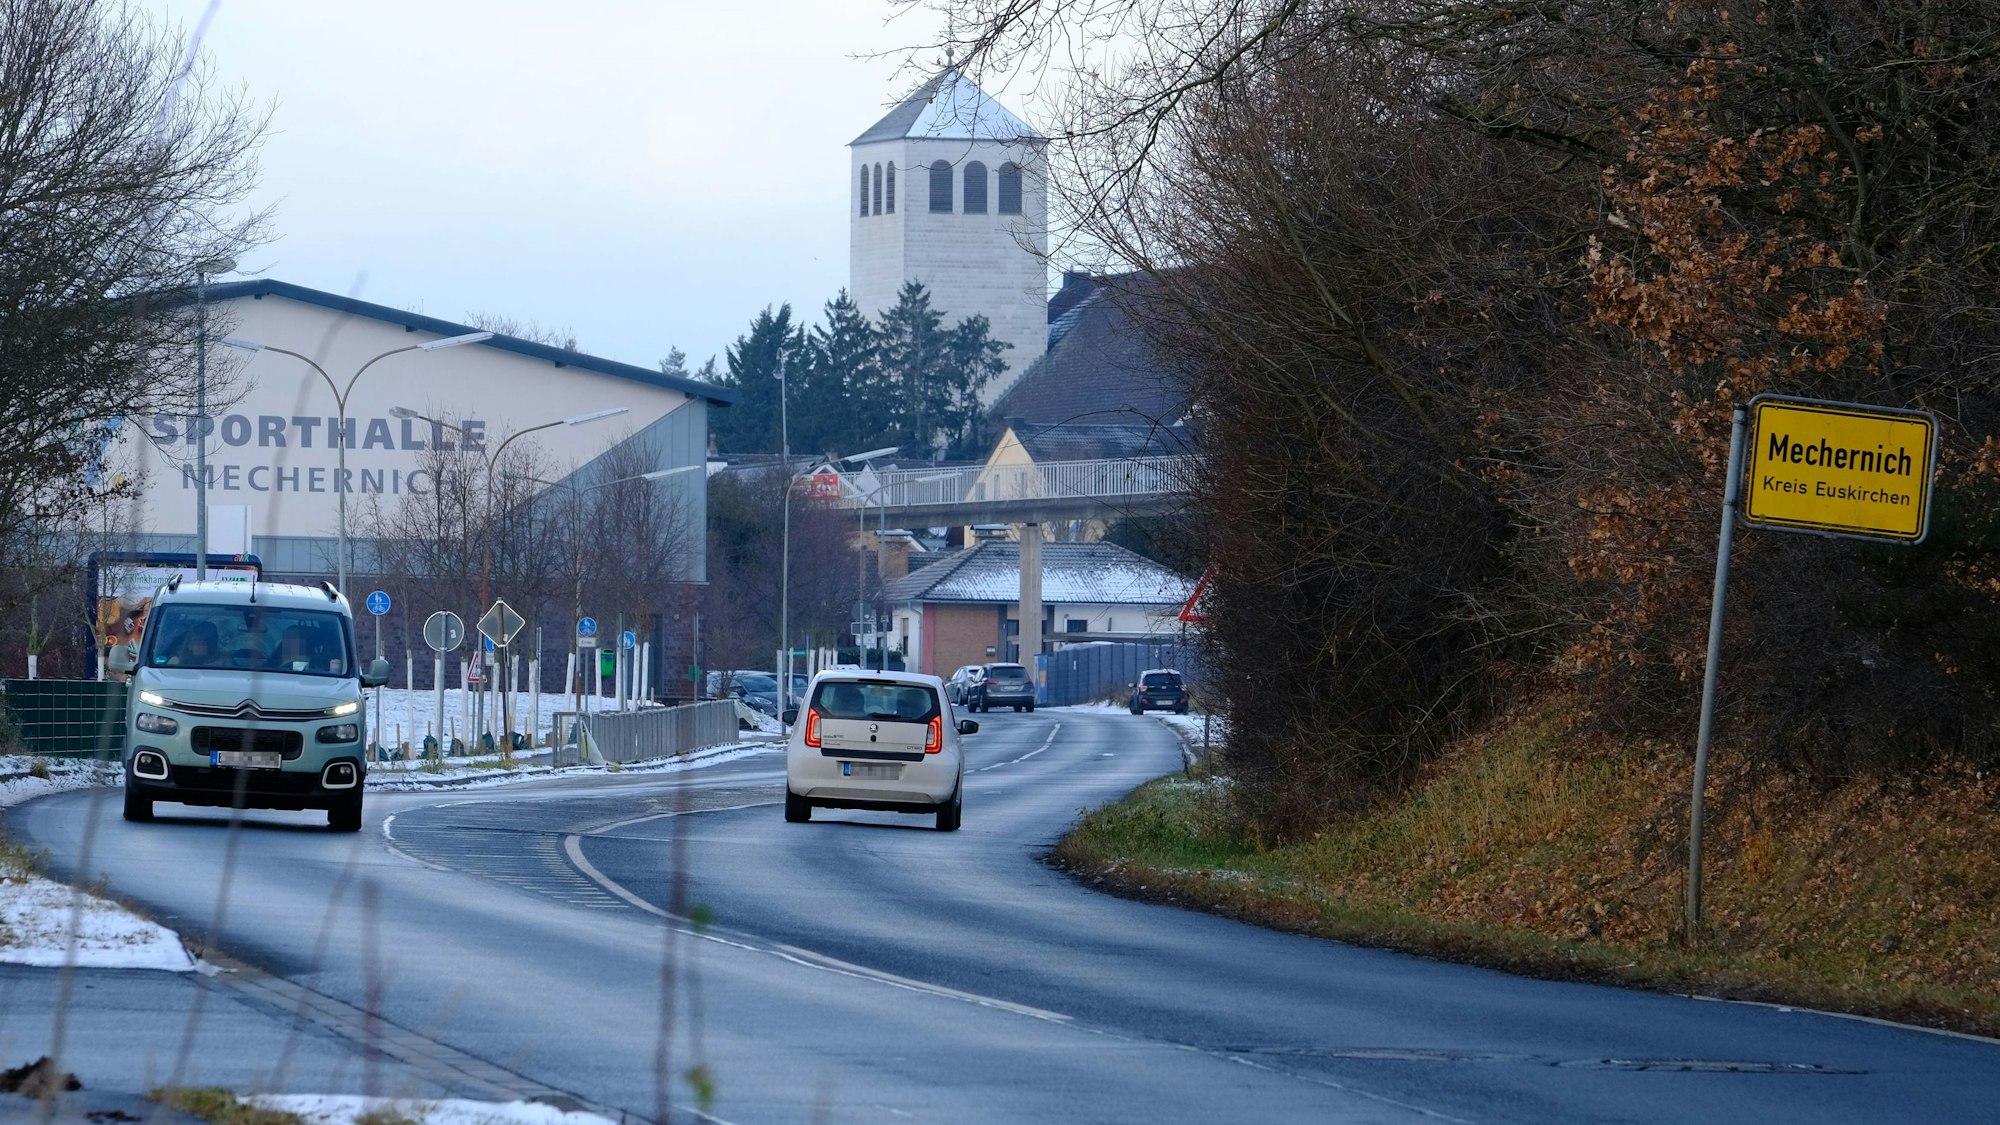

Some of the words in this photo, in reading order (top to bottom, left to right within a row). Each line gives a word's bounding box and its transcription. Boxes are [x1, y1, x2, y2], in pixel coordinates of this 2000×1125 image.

[153, 412, 486, 452] SPORTHALLE
[1768, 432, 1911, 476] Mechernich
[1763, 475, 1808, 494] Kreis
[1815, 481, 1911, 506] Euskirchen
